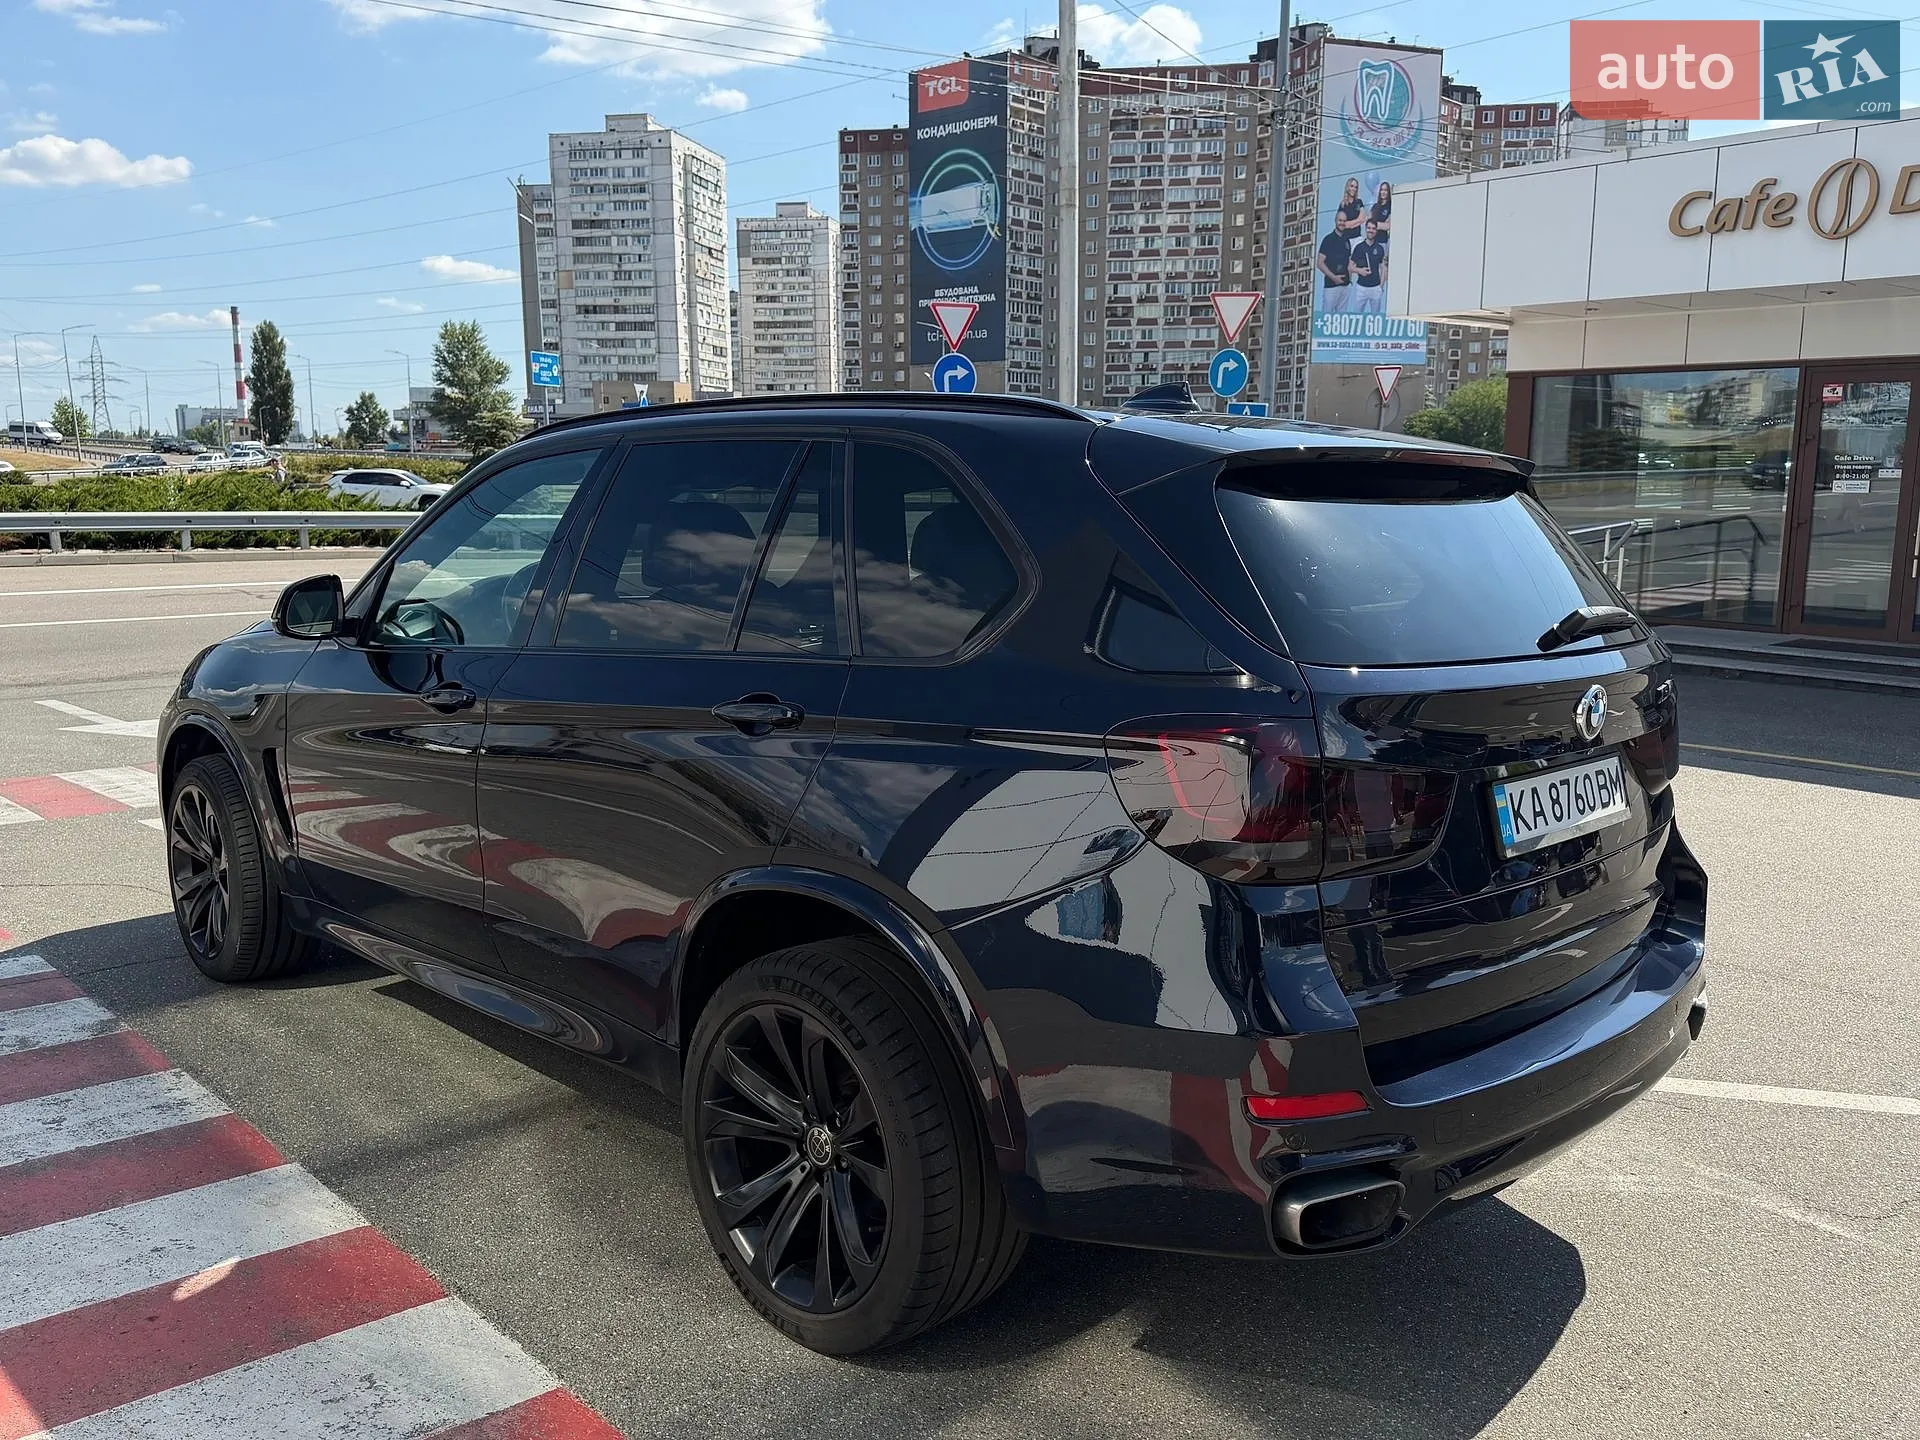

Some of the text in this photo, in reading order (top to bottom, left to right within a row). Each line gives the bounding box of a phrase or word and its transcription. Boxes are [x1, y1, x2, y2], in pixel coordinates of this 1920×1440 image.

[924, 76, 962, 97] TCL
[917, 114, 998, 140] КОНДИЦІОНЕРИ
[1668, 177, 1798, 238] Cafe
[935, 286, 979, 298] ВБУДОВАНА
[1314, 314, 1364, 336] +38077
[1365, 315, 1382, 337] 60
[1509, 765, 1625, 835] KA 8760 BM
